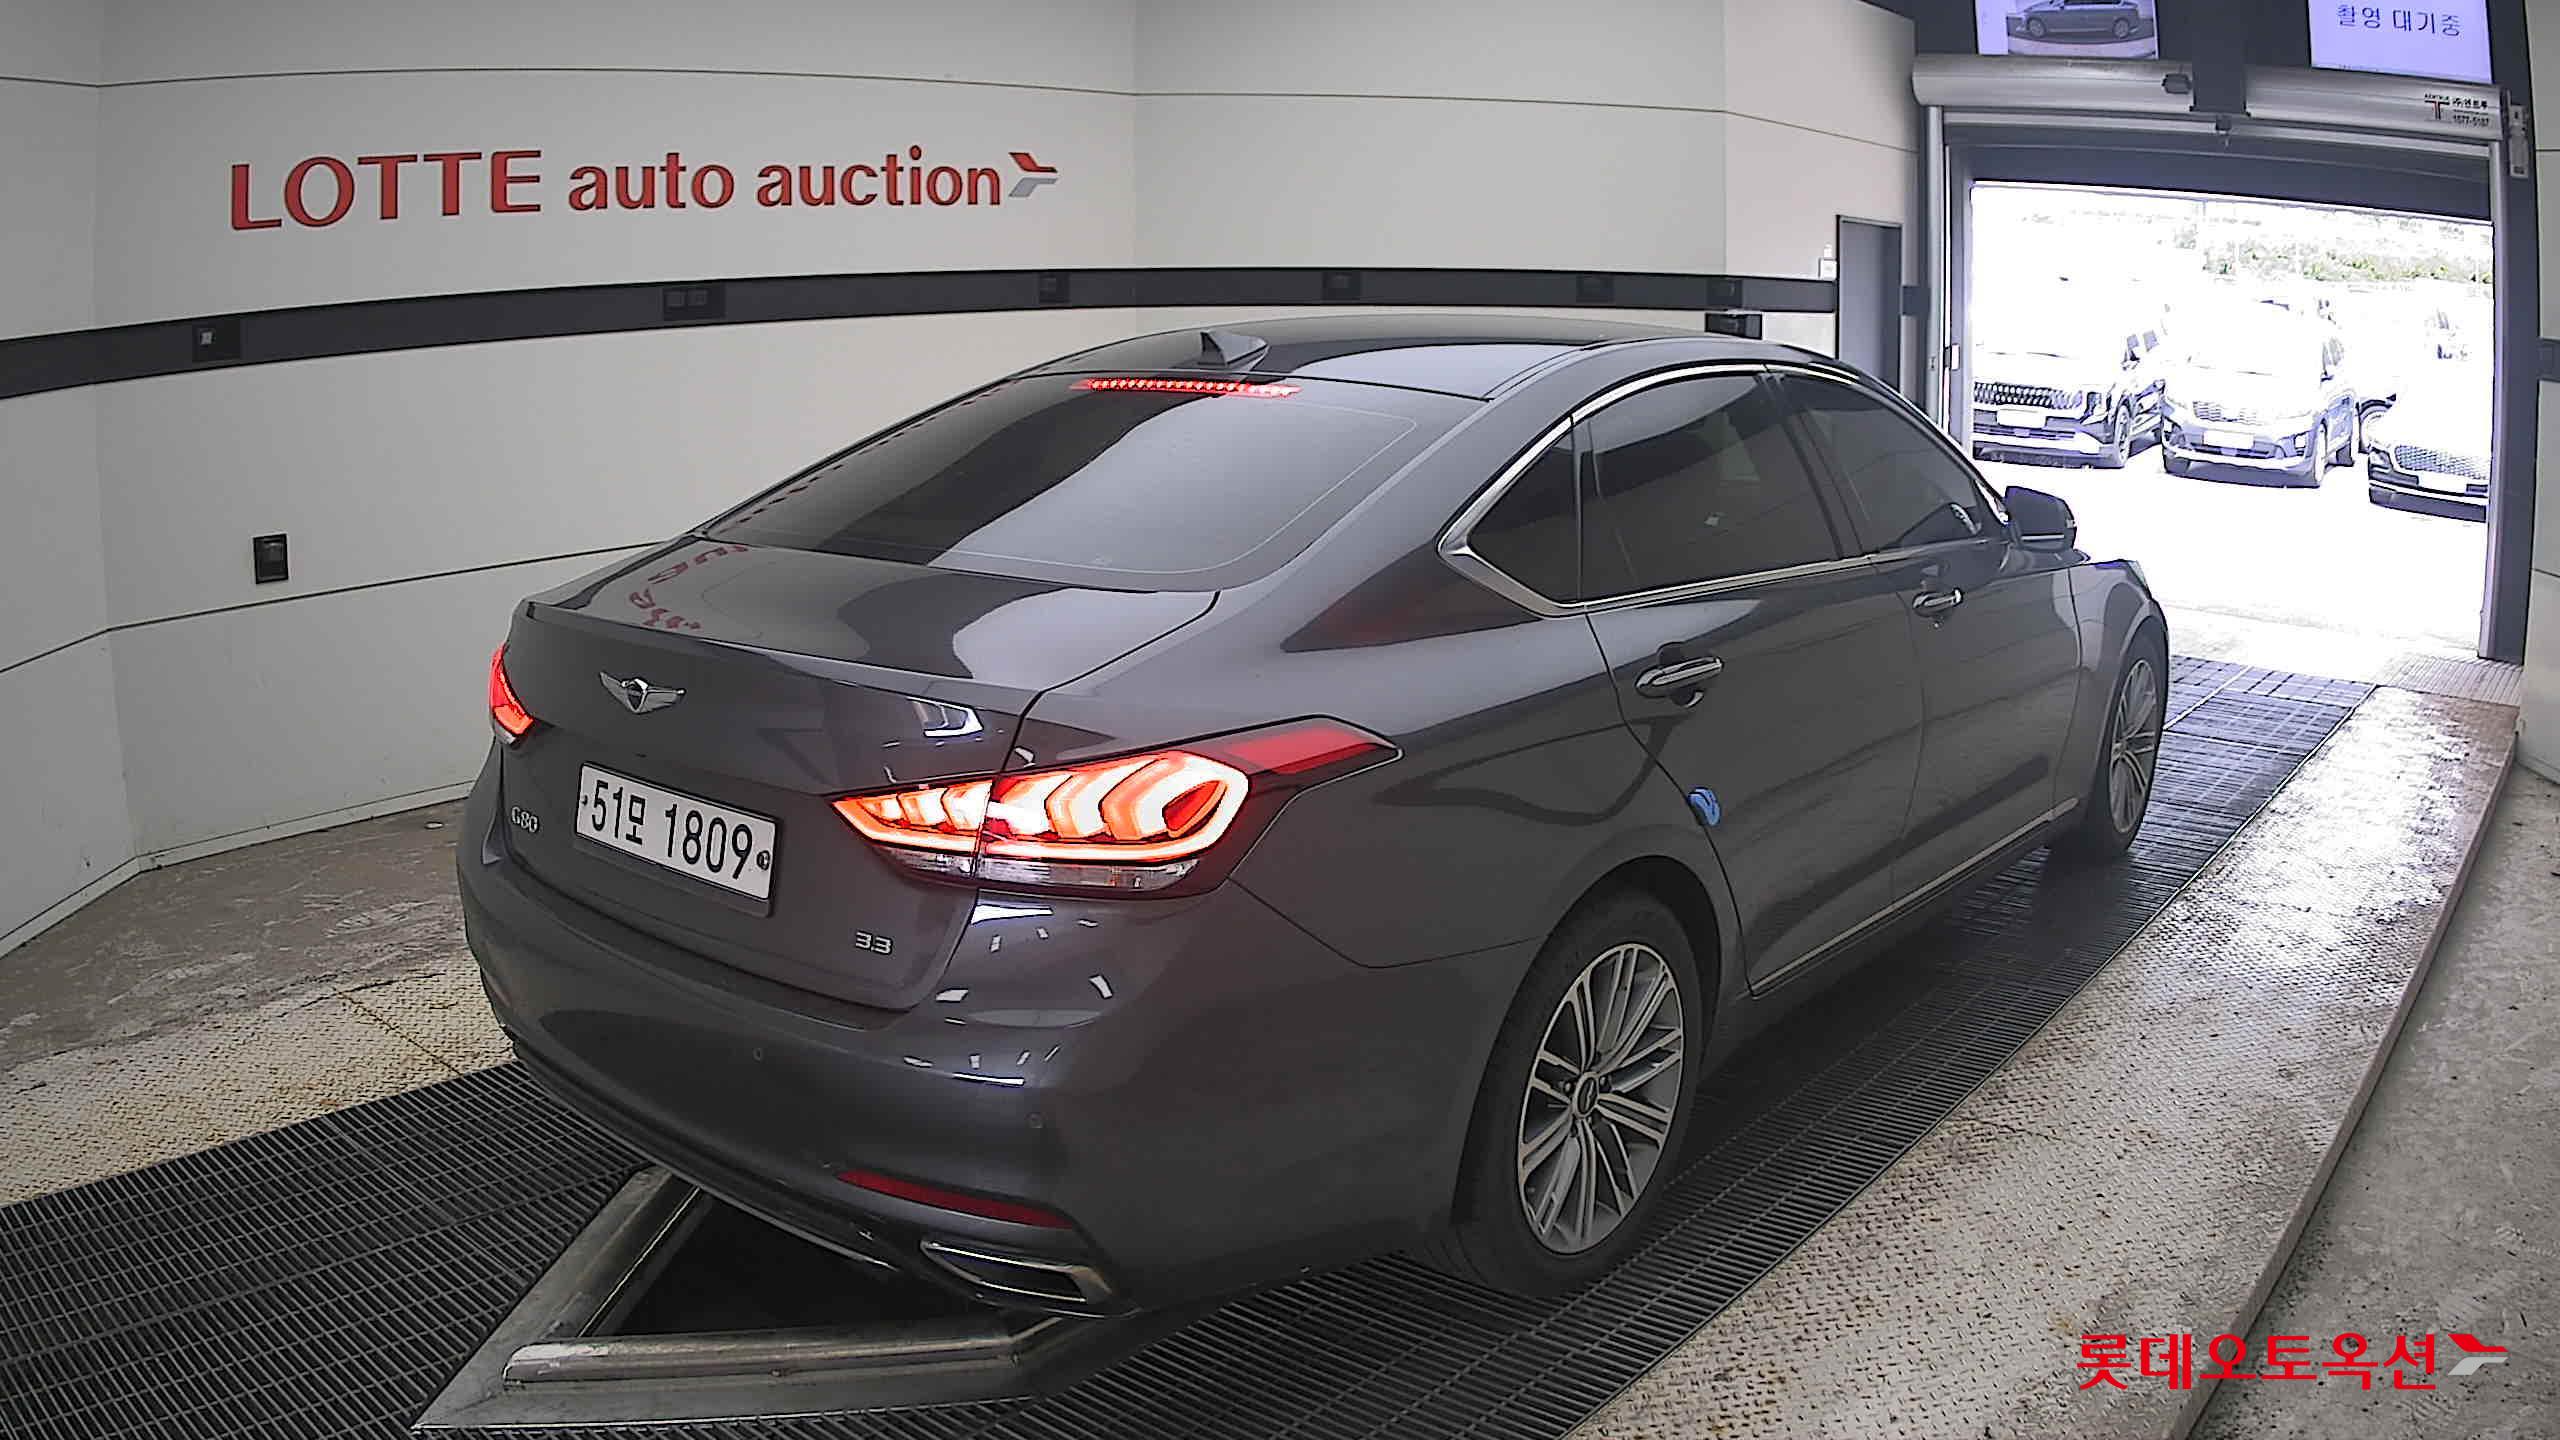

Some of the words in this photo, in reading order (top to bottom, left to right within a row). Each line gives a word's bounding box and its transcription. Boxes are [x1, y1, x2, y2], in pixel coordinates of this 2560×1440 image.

[2338, 4, 2381, 29] 촬영
[2392, 9, 2460, 37] 대기중
[231, 149, 542, 231] LOTTE
[567, 151, 736, 210] auto
[756, 145, 1001, 208] auction
[511, 806, 538, 833] G80
[664, 803, 753, 880] 1809
